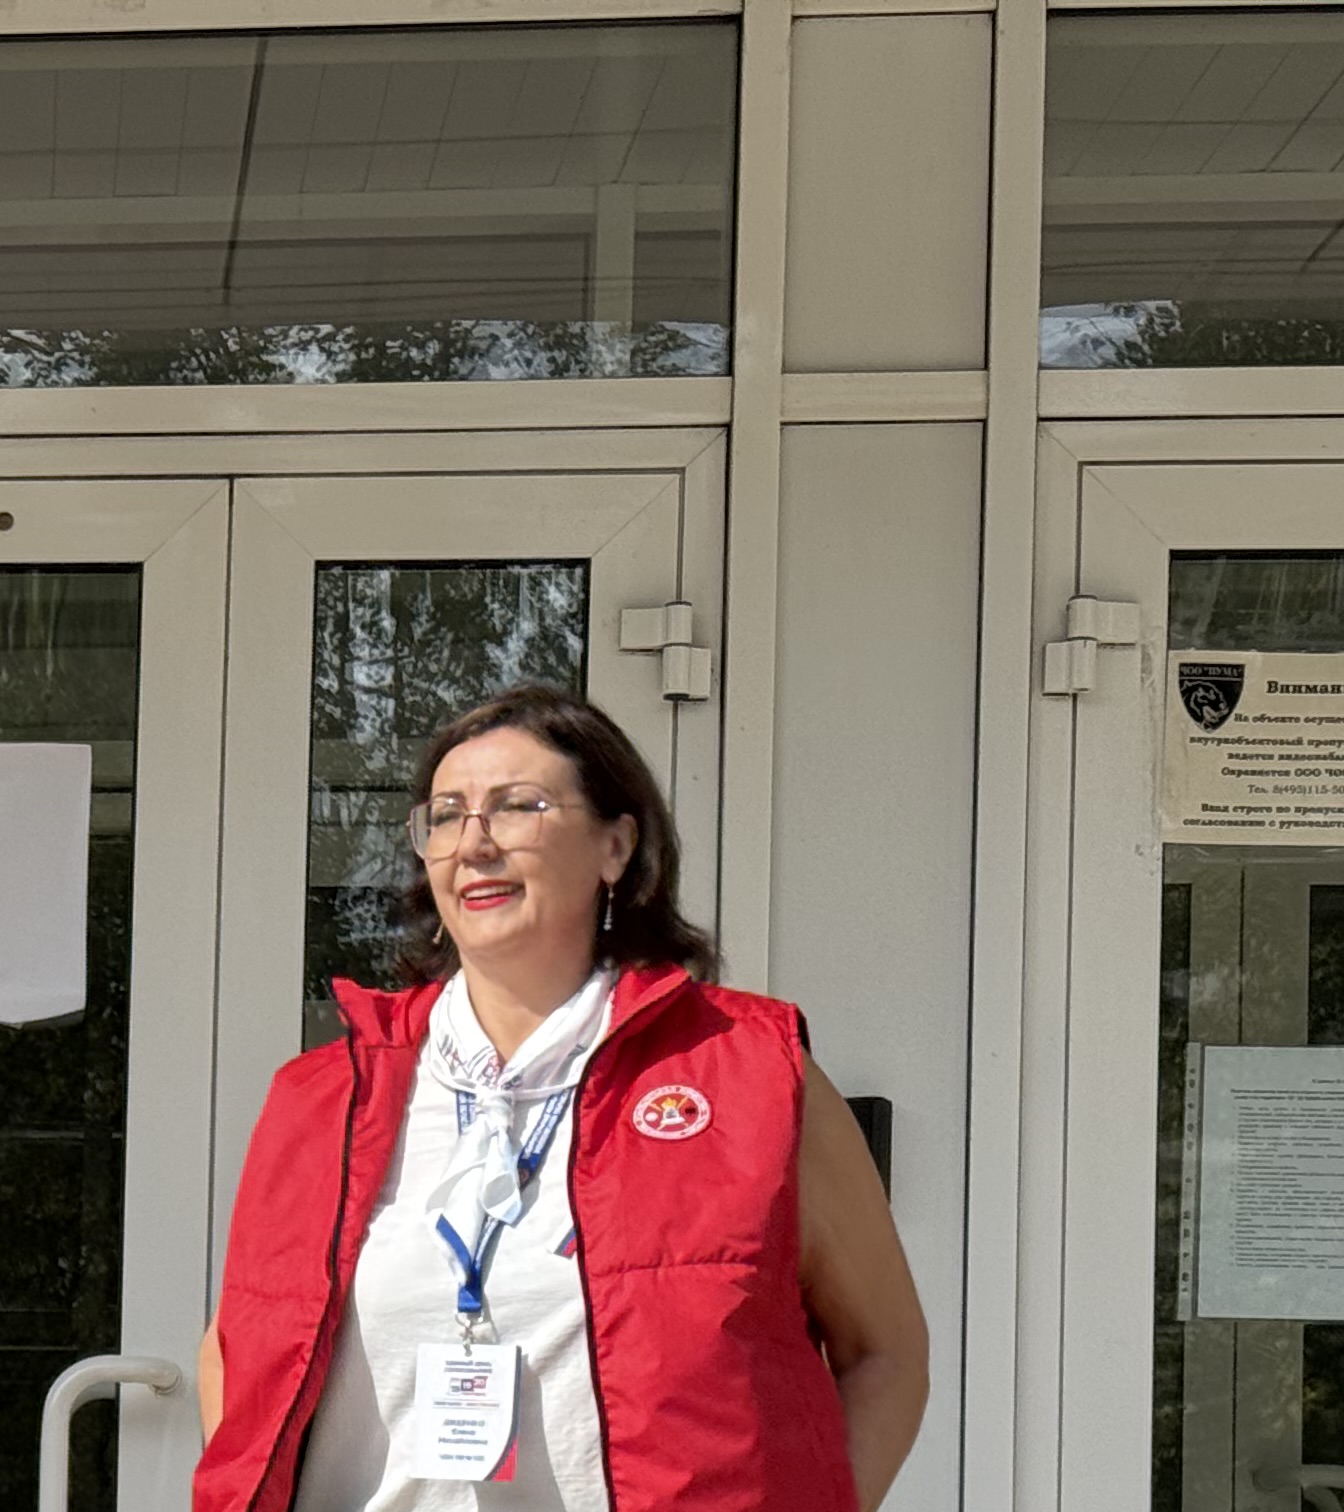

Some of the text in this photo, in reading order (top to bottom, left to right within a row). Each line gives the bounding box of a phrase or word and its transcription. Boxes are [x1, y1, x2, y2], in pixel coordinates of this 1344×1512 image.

[1266, 680, 1344, 694] Вниман
[1234, 713, 1344, 725] На объекте осуще
[1307, 739, 1344, 748] пропу
[1278, 751, 1344, 762] видеонабл
[1294, 768, 1322, 778] ООО
[1325, 768, 1344, 778] ЧО
[1232, 805, 1273, 816] строго
[1275, 806, 1291, 814] по
[1268, 819, 1277, 828] с
[1279, 819, 1344, 829] руководст
